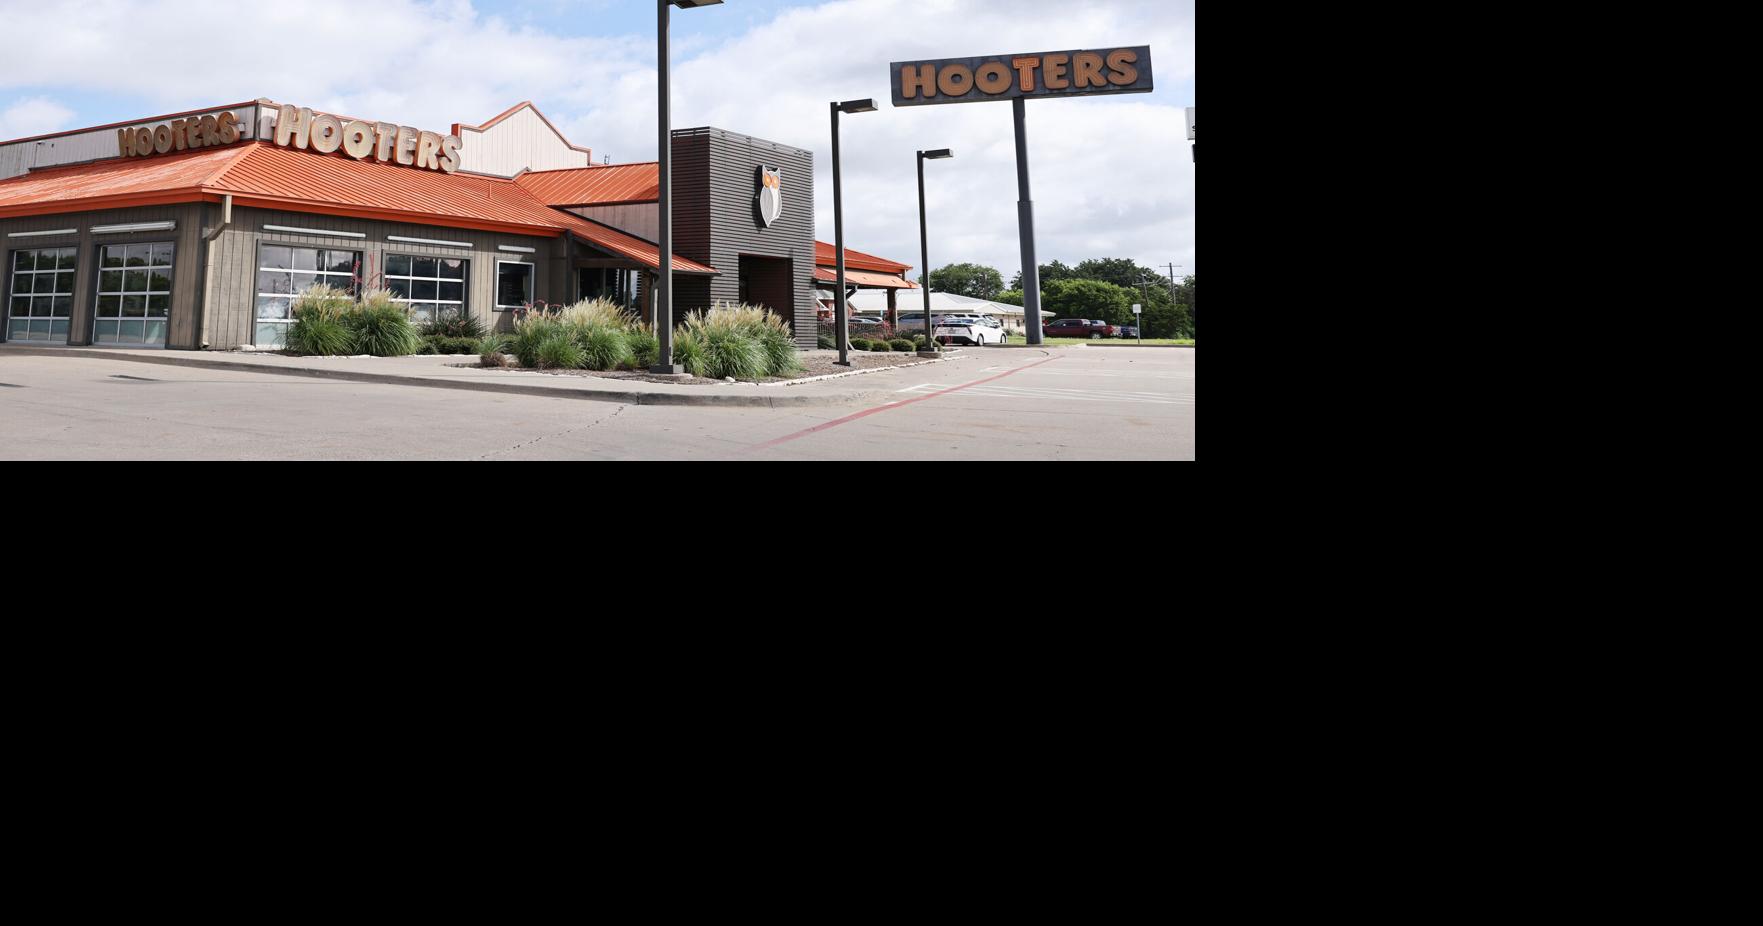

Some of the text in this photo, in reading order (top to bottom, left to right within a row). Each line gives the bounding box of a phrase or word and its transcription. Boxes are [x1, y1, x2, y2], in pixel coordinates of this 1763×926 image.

[902, 50, 1138, 99] HOOTERS
[118, 112, 239, 157] HOOTERS
[275, 104, 462, 173] HOOTERS
